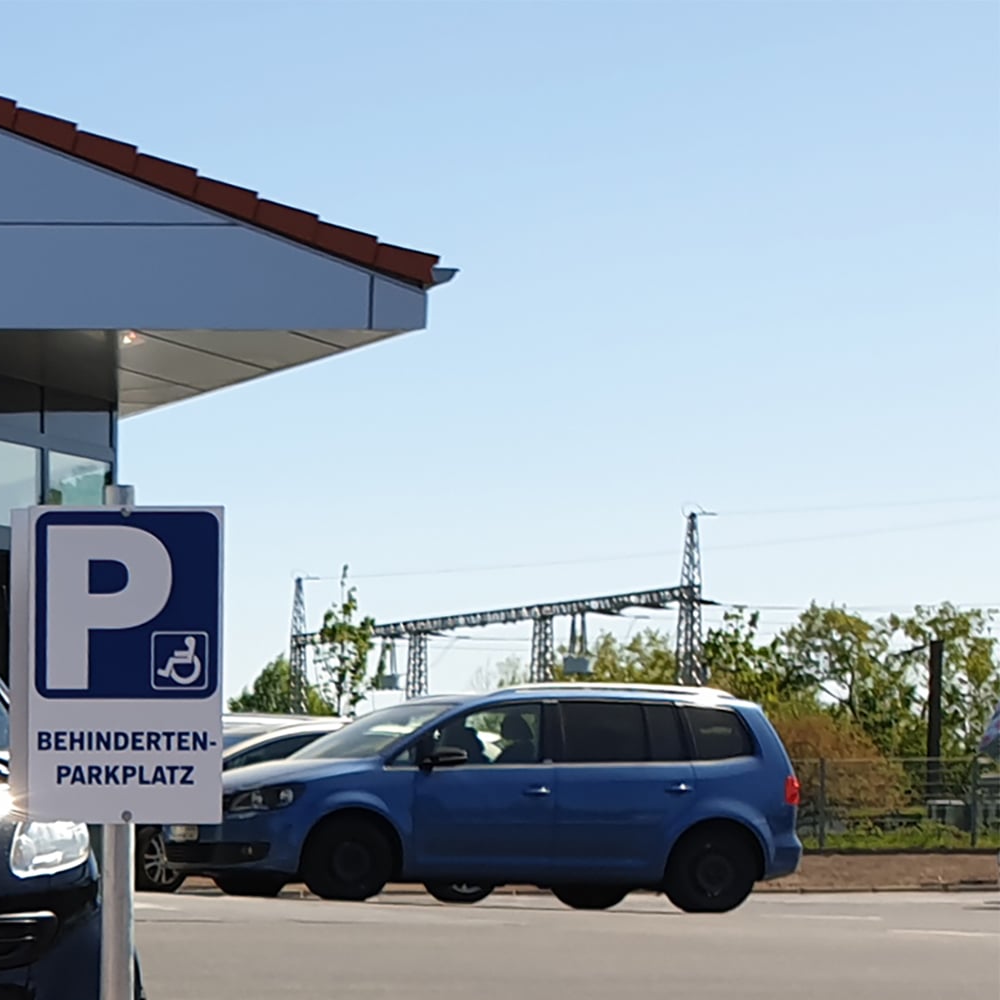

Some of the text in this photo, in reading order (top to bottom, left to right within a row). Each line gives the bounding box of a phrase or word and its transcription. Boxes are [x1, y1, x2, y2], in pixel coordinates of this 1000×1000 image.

[46, 524, 172, 690] P
[37, 730, 217, 752] BEHINDERTEN-
[56, 764, 195, 786] PARKPLATZ
